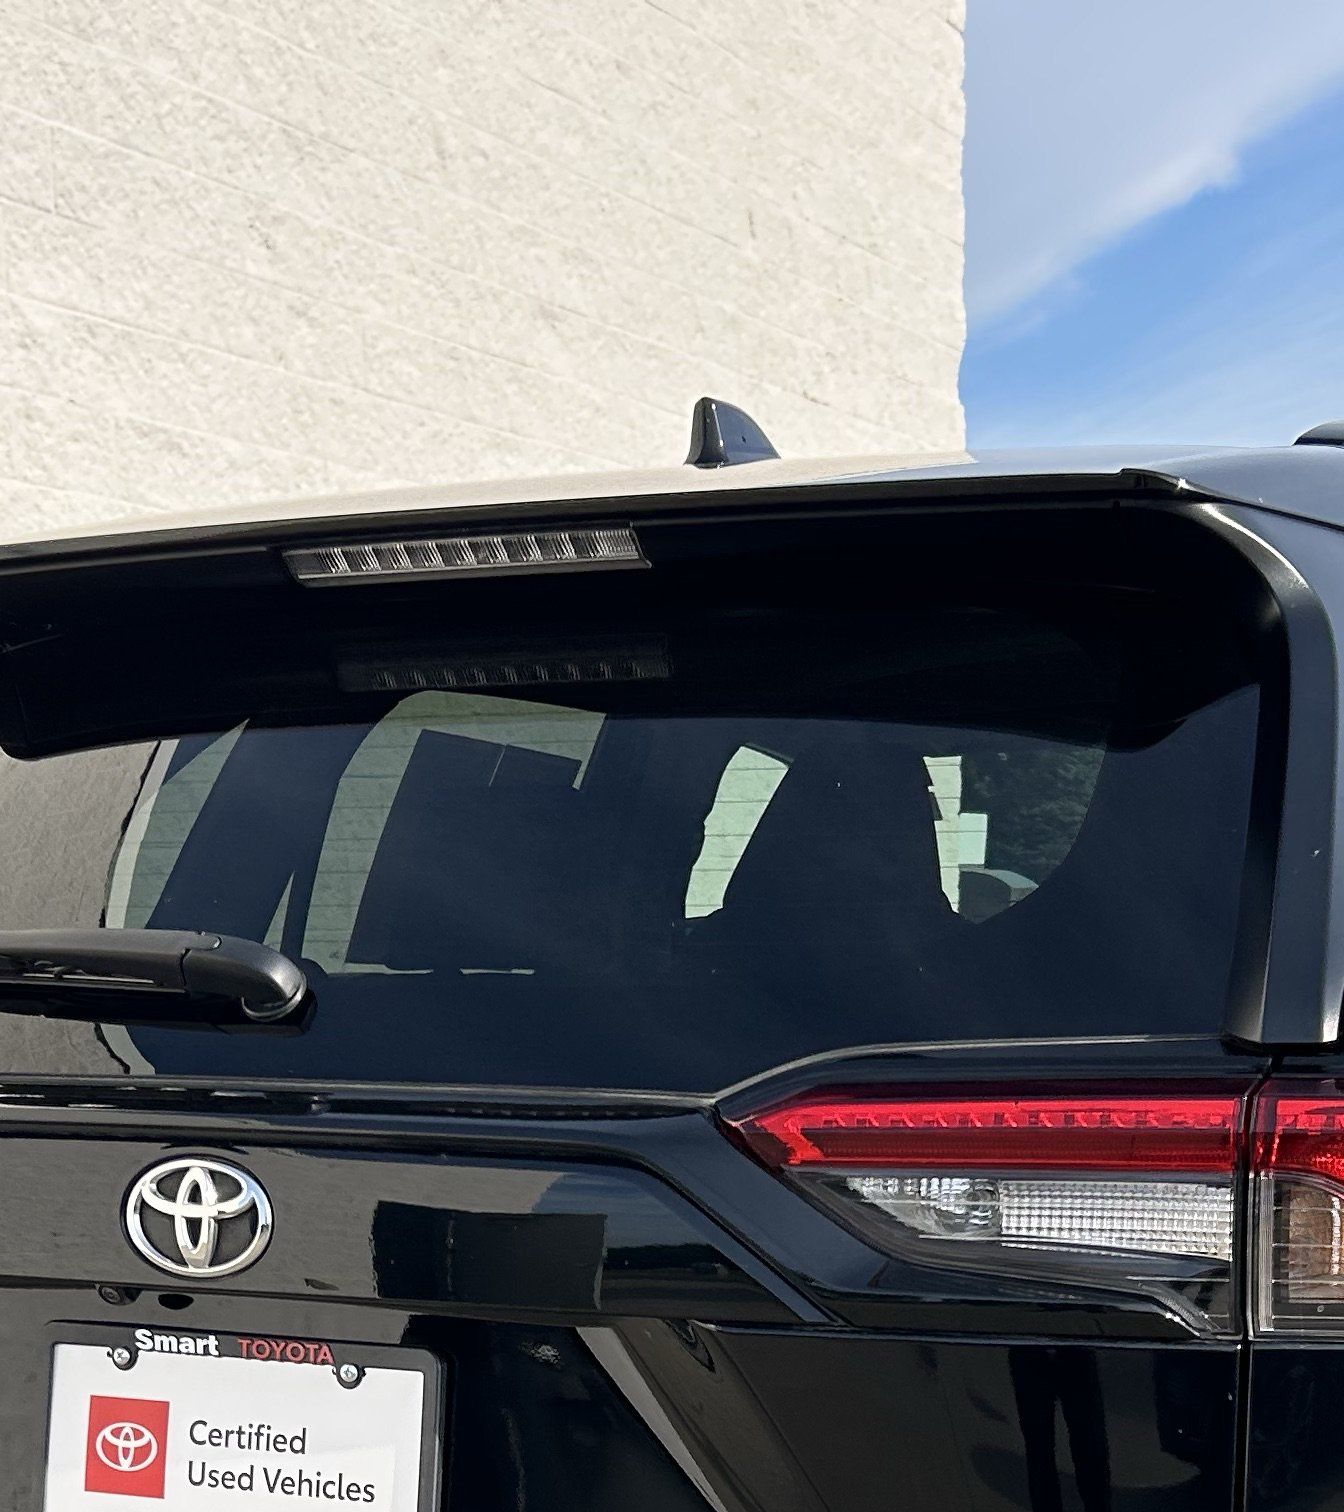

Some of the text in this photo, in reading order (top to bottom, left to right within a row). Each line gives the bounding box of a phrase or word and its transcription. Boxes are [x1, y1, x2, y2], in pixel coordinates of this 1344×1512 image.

[134, 1329, 335, 1364] Smart TOYOTA
[189, 1419, 307, 1455] Certified
[187, 1460, 376, 1503] Used Vehicles
